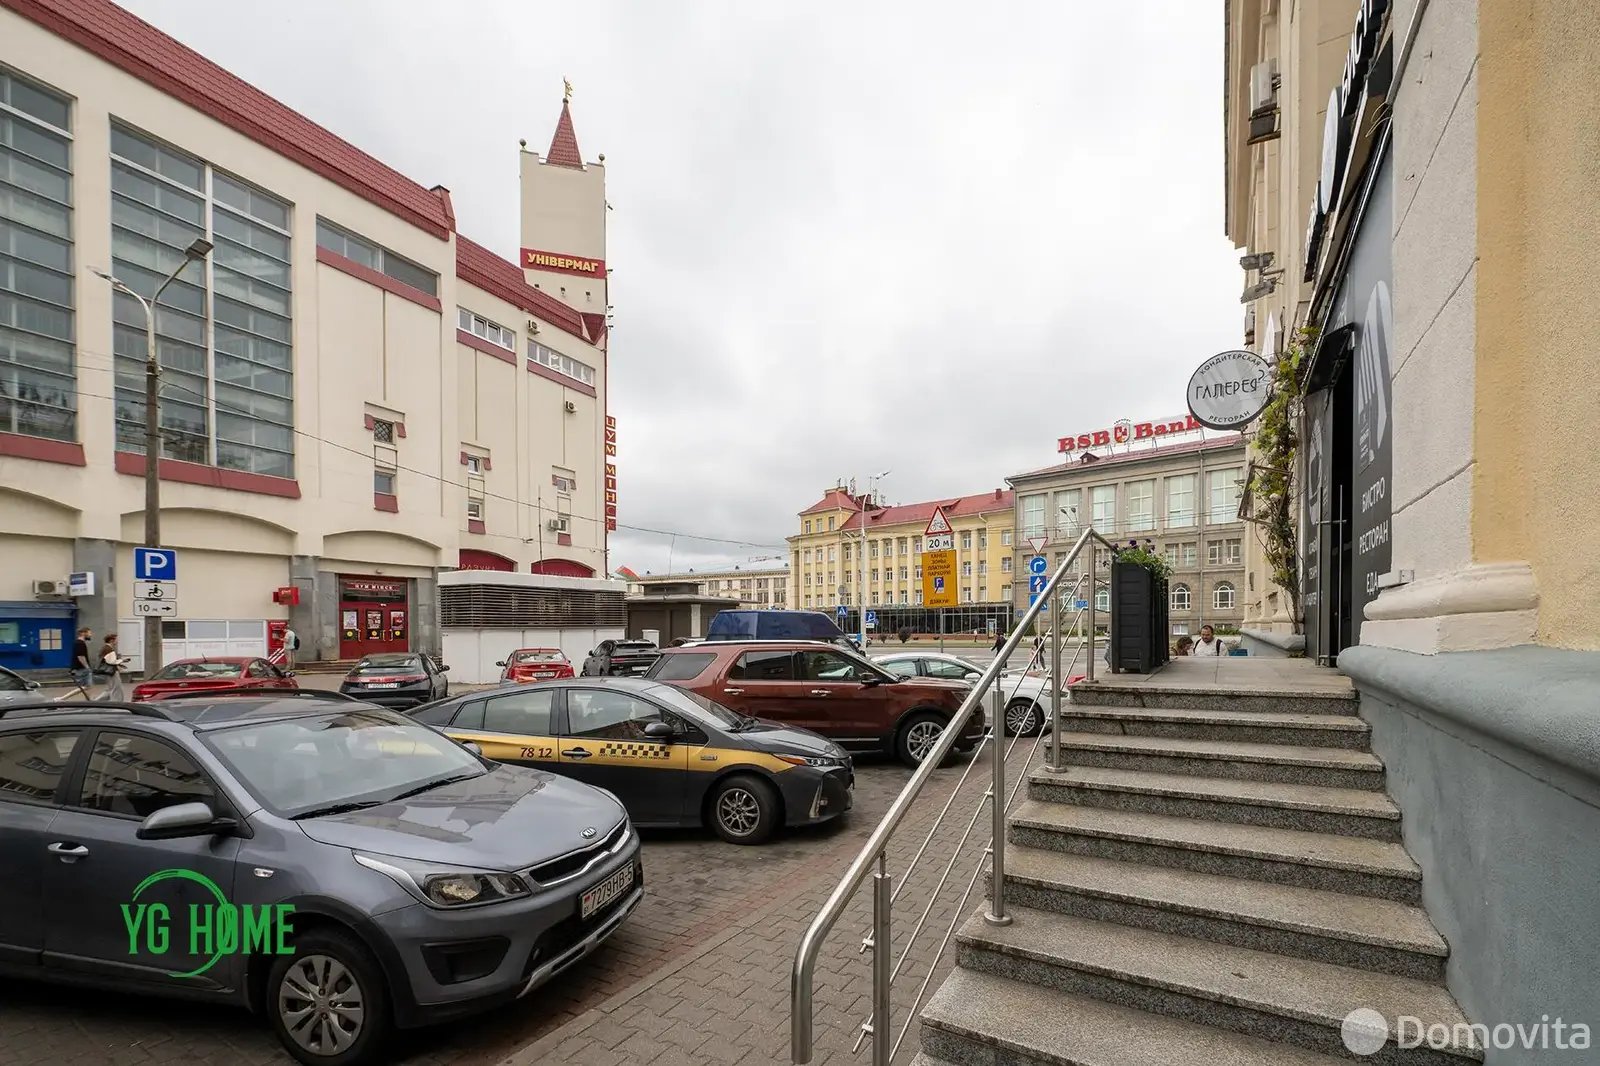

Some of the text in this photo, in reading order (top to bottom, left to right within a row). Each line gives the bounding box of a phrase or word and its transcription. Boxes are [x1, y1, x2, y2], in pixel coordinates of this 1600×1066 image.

[527, 252, 599, 272] УНІВЕРМАГ
[1199, 353, 1261, 375] КОНДИТЕРСКАЯ
[1195, 370, 1264, 400] ГАЛЕРЕЯ
[1209, 410, 1250, 423] РЕСТОРАН
[606, 416, 616, 455] ЦУМ
[1057, 430, 1111, 453] BSB
[1362, 476, 1386, 513] БИСТРО
[929, 539, 940, 548] 20
[1359, 519, 1389, 555] РЕСТОРАН
[145, 552, 167, 576] P
[138, 604, 150, 612] 10
